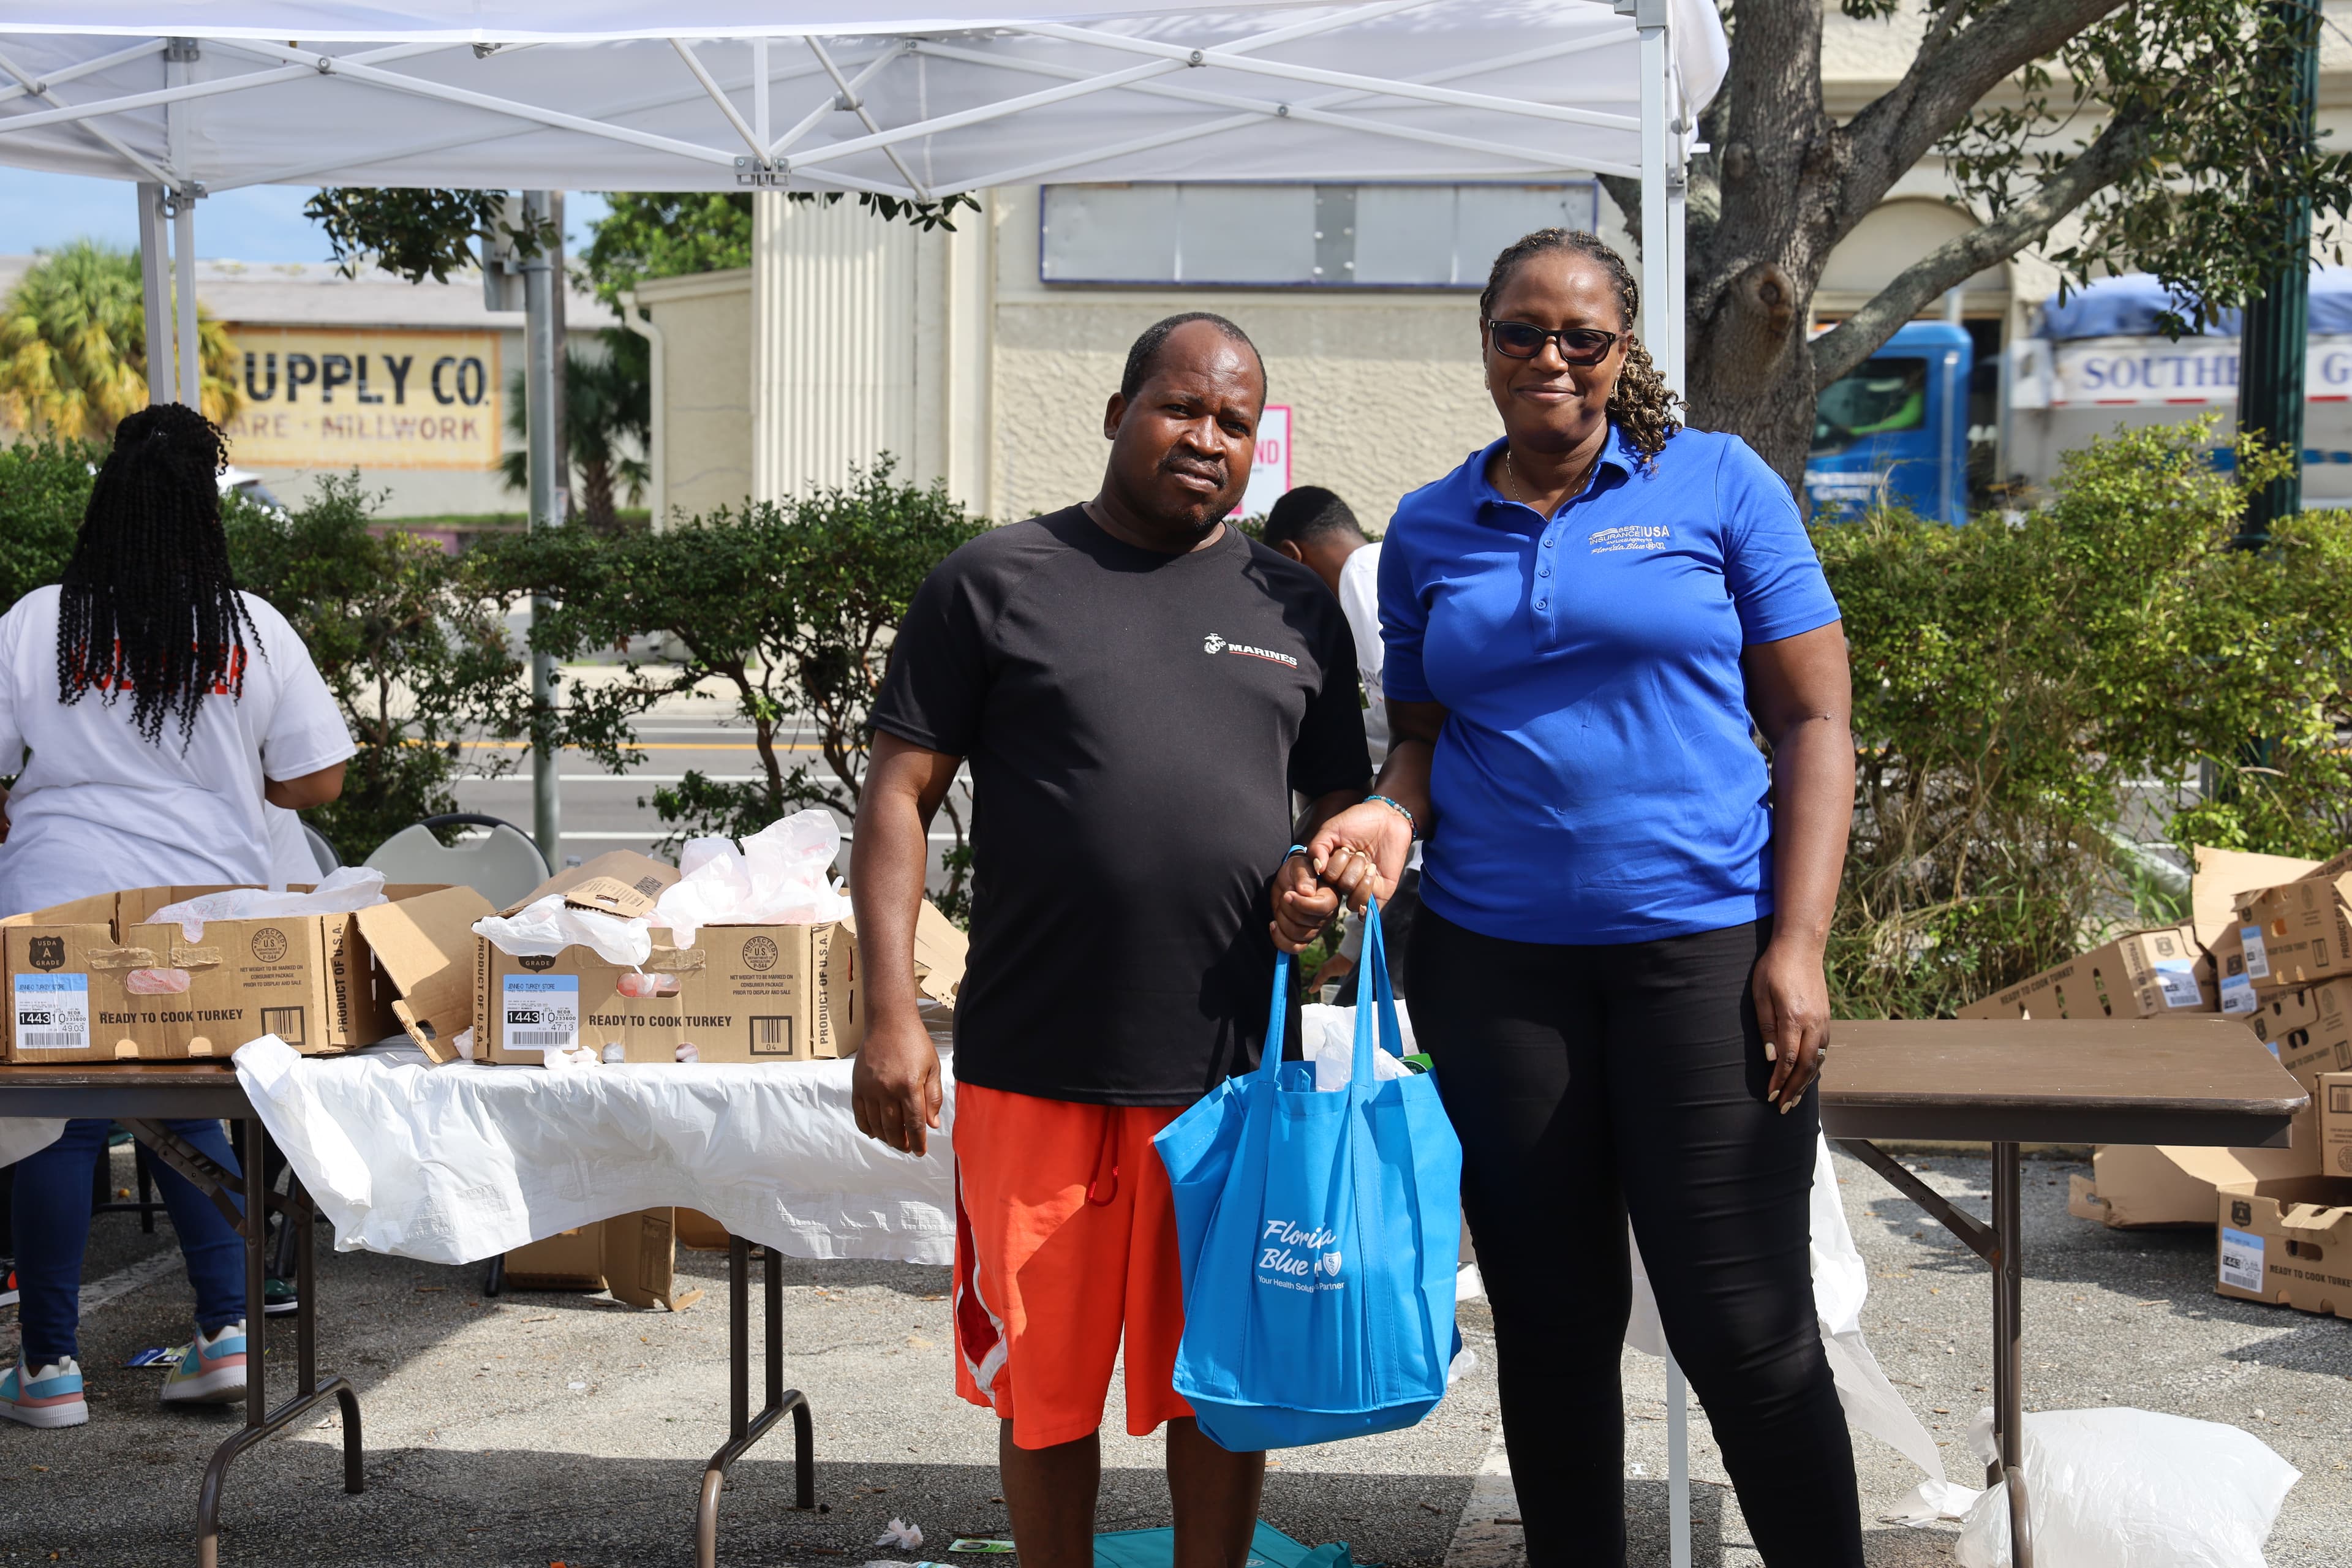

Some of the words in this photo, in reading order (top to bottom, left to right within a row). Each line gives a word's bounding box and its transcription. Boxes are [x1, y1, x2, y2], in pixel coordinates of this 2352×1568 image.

[231, 352, 412, 405] UPPLY
[431, 355, 489, 405] CO.
[2083, 356, 2240, 390] SOUTHE
[322, 415, 481, 441] MILLWORK
[1253, 440, 1279, 464] ND
[1590, 531, 1641, 545] INSURANCE
[1644, 526, 1670, 537] USA
[1591, 543, 1625, 554] Florida
[1228, 644, 1297, 666] MARINES
[254, 930, 285, 944] INSPECTED
[333, 923, 344, 956] U.S.A.
[745, 938, 776, 952] INSPECTED
[43, 947, 51, 957] A
[819, 934, 828, 968] U.S.A.
[334, 960, 344, 976] OF
[819, 971, 828, 986] OF
[336, 980, 348, 1033] PRODUCT
[477, 995, 484, 1009] OF
[100, 1013, 137, 1023] READY
[141, 1012, 156, 1023] TO
[161, 1011, 194, 1022] COOK
[197, 1009, 243, 1021] TURKEY
[589, 1015, 626, 1025] READY
[630, 1016, 644, 1026] TO
[649, 1016, 682, 1027] COOK
[685, 1016, 731, 1027] TURKEY
[819, 990, 828, 1044] PRODUCT
[1263, 1219, 1336, 1249] Floria
[1259, 1248, 1309, 1276] Blue
[1258, 1275, 1272, 1284] Your
[1273, 1279, 1294, 1289] Health
[1295, 1283, 1319, 1293] Solutis
[1319, 1282, 1344, 1291] Partner
[2269, 1264, 2291, 1276] READY
[2294, 1269, 2303, 1279] TO
[2305, 1272, 2326, 1283] COOK
[2328, 1275, 2352, 1287] TURKE
